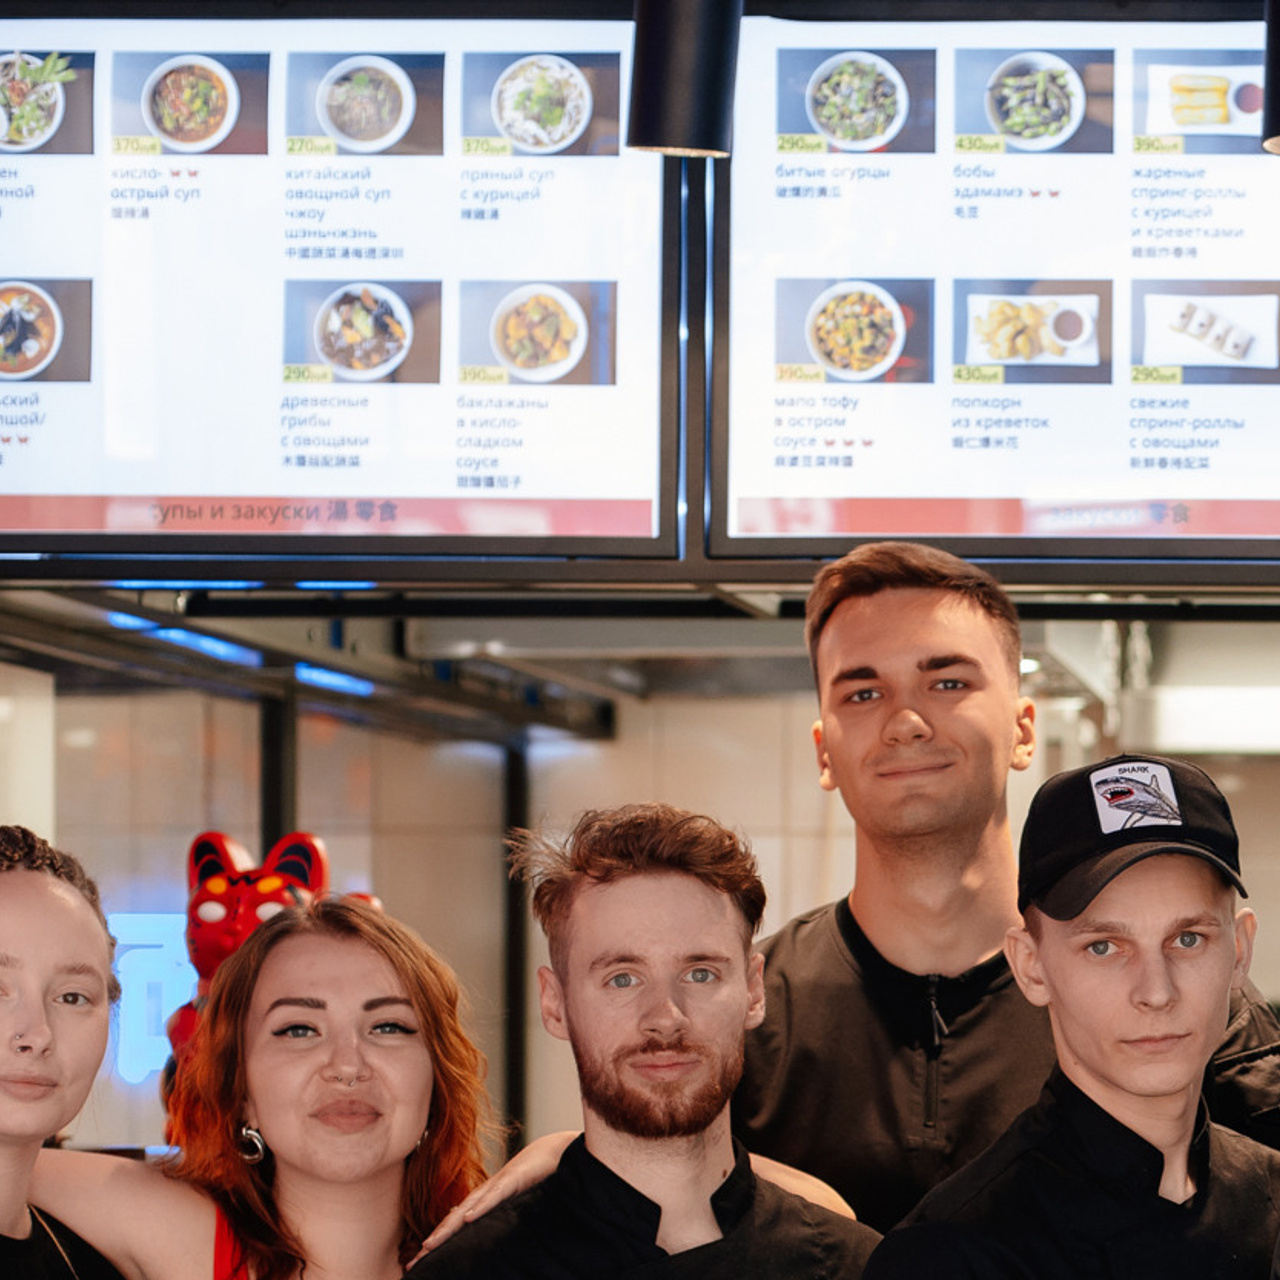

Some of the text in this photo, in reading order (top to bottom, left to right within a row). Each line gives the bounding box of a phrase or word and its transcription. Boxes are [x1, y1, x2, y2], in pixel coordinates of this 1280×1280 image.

[285, 166, 372, 180] китайский
[460, 167, 555, 186] пряный суп
[774, 163, 826, 179] битые
[953, 164, 996, 178] бобы
[1132, 168, 1206, 181] жареные
[110, 185, 201, 203] острый суп
[285, 186, 391, 203] овощной суп
[460, 187, 540, 203] с курицей
[1131, 205, 1213, 222] с курицей
[1130, 227, 1244, 240] и креветками
[0, 393, 39, 406] ский
[279, 395, 368, 411] древесные
[456, 394, 549, 409] баклажаны
[822, 395, 859, 411] тофу
[952, 397, 1022, 411] попкорн
[1129, 398, 1190, 409] свежие
[280, 414, 331, 431] грибы
[774, 417, 847, 430] в остром
[952, 417, 1050, 431] из креветок
[1129, 418, 1245, 431] спринг-роллы
[281, 436, 370, 449] с овощами
[456, 437, 523, 450] сладком
[773, 436, 817, 450] соусе
[1129, 437, 1220, 450] с овощами
[456, 457, 499, 472] соусе
[210, 504, 224, 519] и
[231, 504, 320, 524] закуски
[1118, 766, 1150, 774] SHARK
